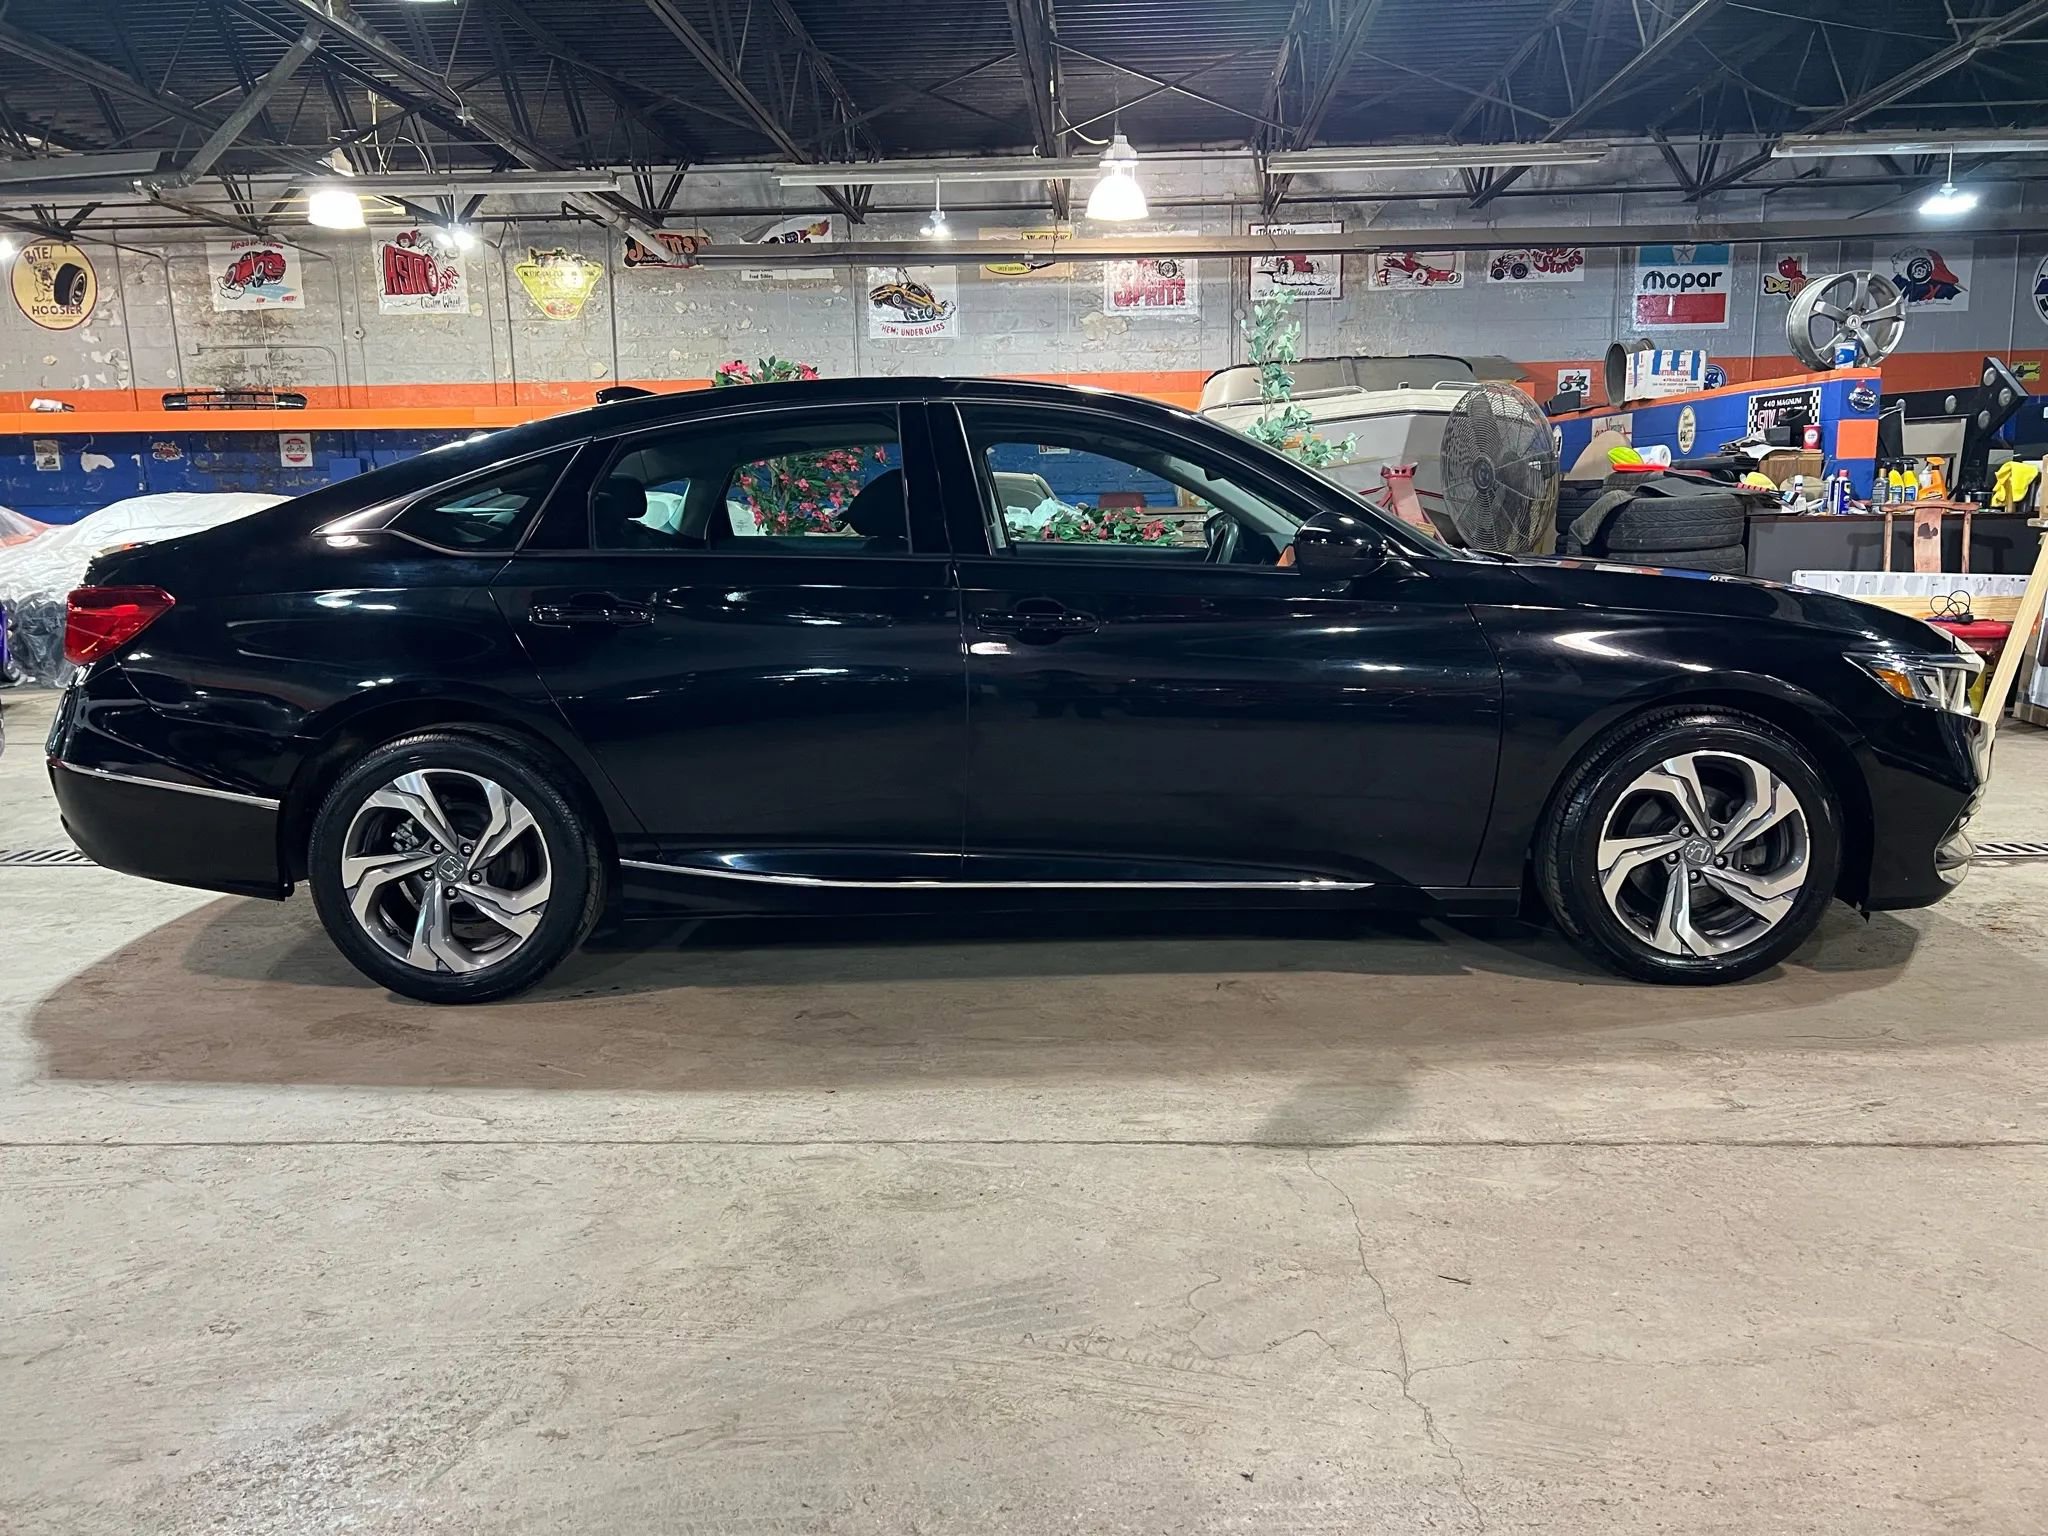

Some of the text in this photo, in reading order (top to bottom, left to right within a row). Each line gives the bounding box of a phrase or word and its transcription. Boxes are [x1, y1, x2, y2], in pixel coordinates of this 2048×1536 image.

[1533, 250, 1584, 274] Stones
[32, 305, 83, 315] HOOSIER
[900, 328, 924, 337] UNDER
[924, 323, 946, 335] GLASS
[1777, 397, 1803, 406] MAGNUM
